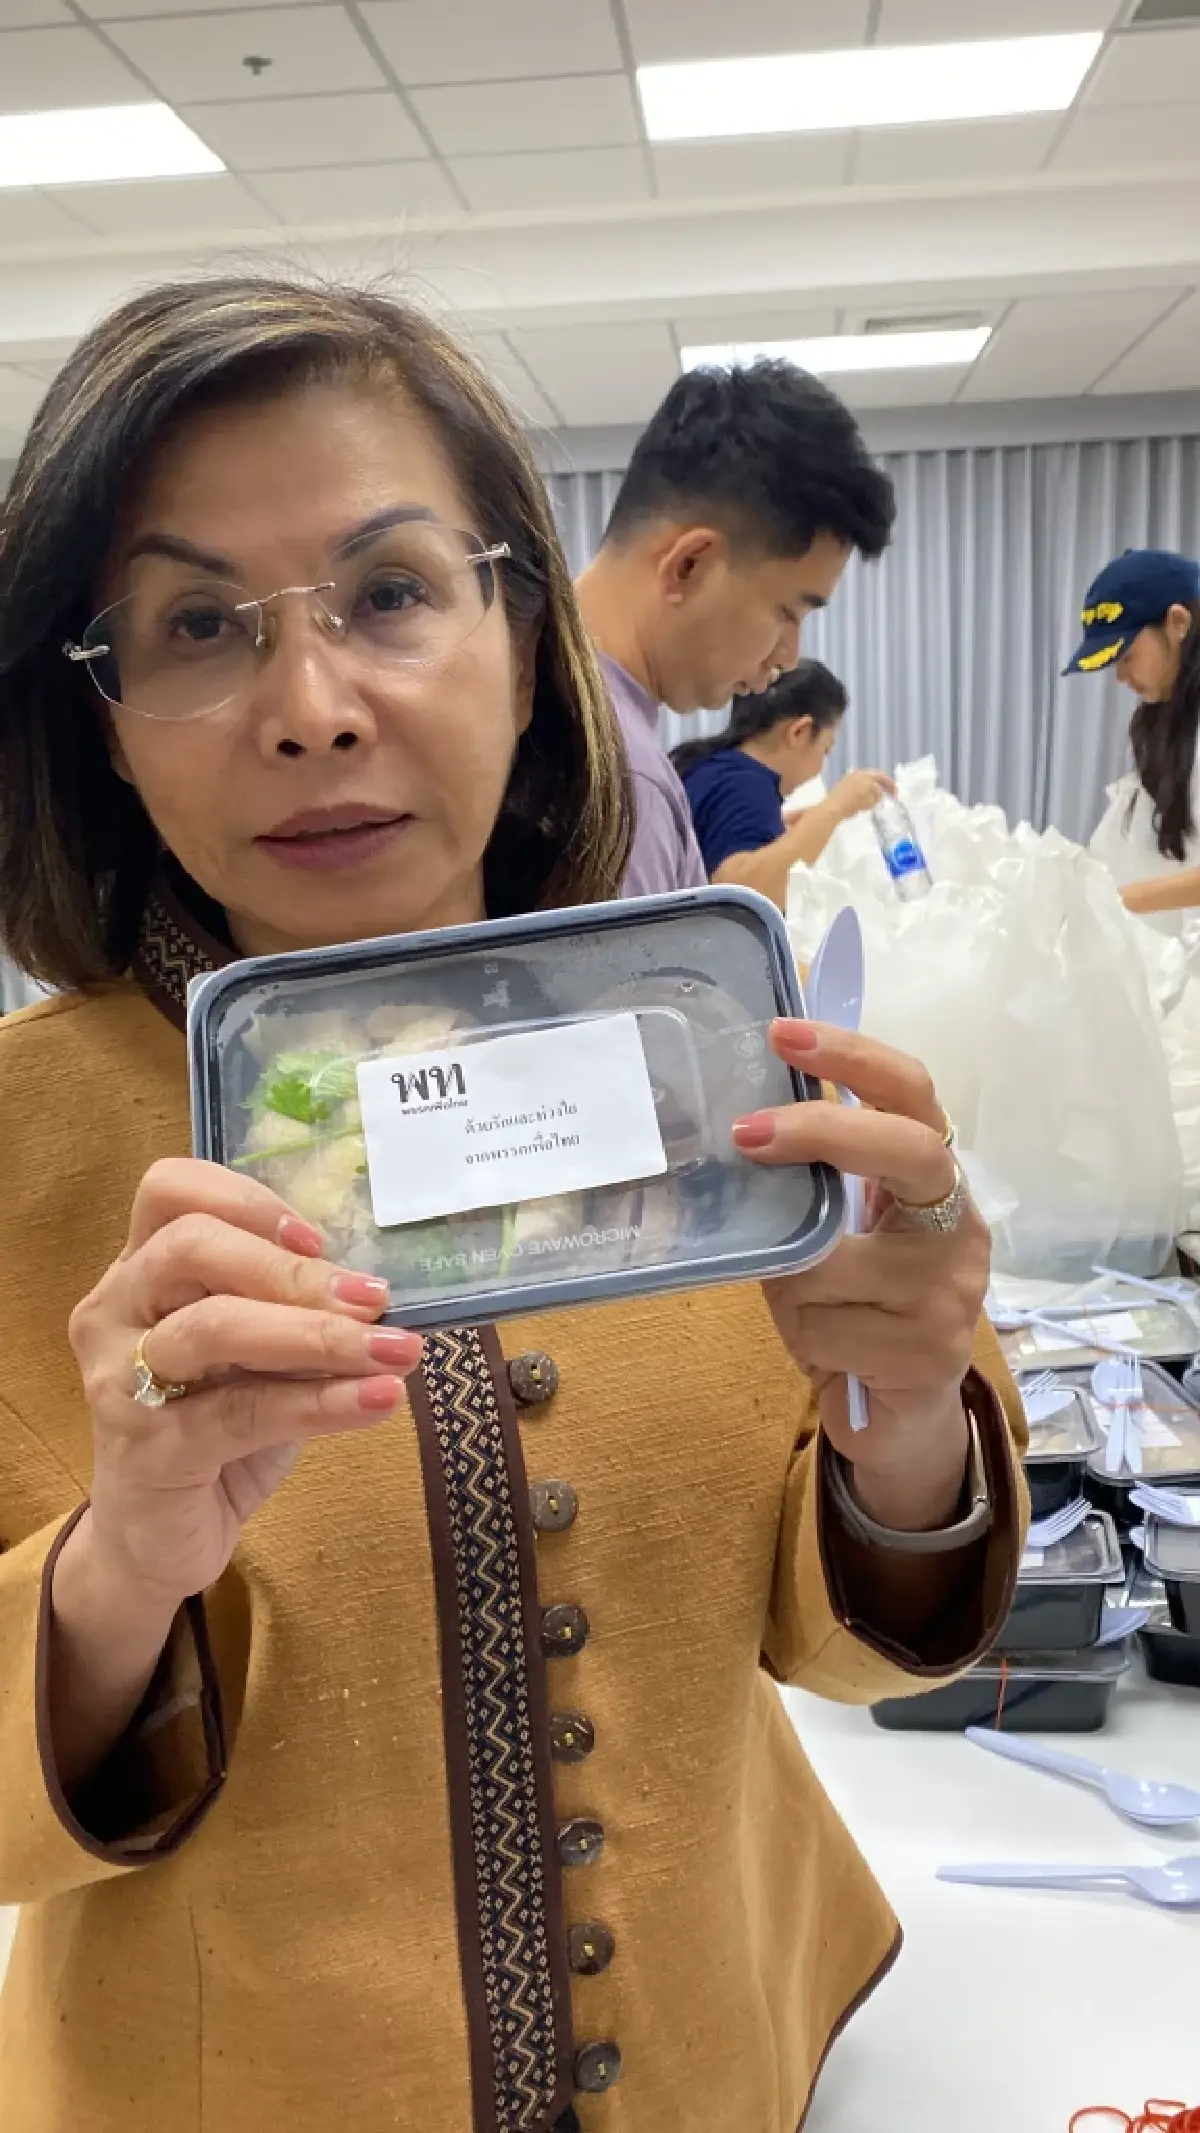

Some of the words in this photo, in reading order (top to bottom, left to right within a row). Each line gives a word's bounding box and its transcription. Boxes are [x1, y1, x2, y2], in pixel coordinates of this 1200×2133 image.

[389, 1063, 466, 1103] พท
[528, 1224, 641, 1256] MICROWAVE
[420, 1252, 468, 1272] SAFE
[473, 1245, 524, 1264] OVEN
